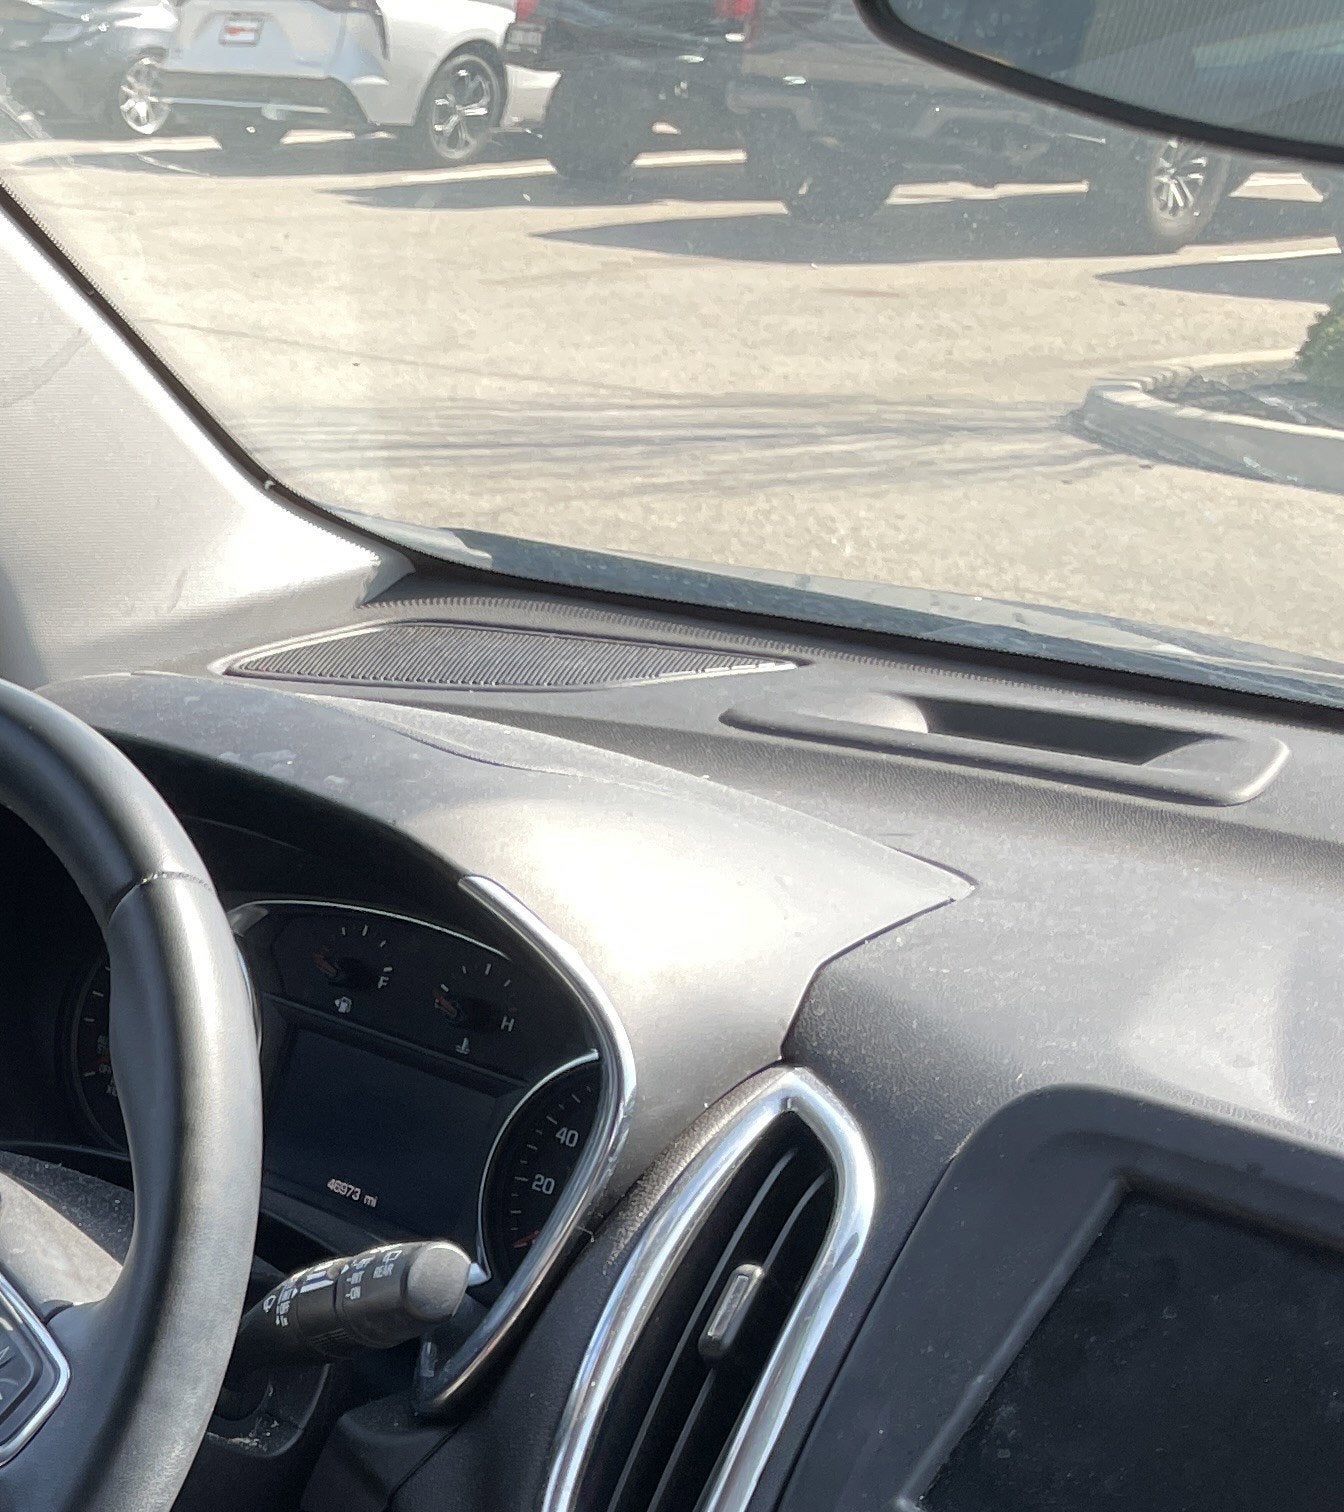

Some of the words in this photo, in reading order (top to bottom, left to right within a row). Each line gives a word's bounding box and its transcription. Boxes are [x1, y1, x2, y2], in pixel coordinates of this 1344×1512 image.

[377, 975, 390, 989] F
[500, 1015, 515, 1032] H
[555, 1126, 580, 1149] 40
[531, 1173, 556, 1195] 20
